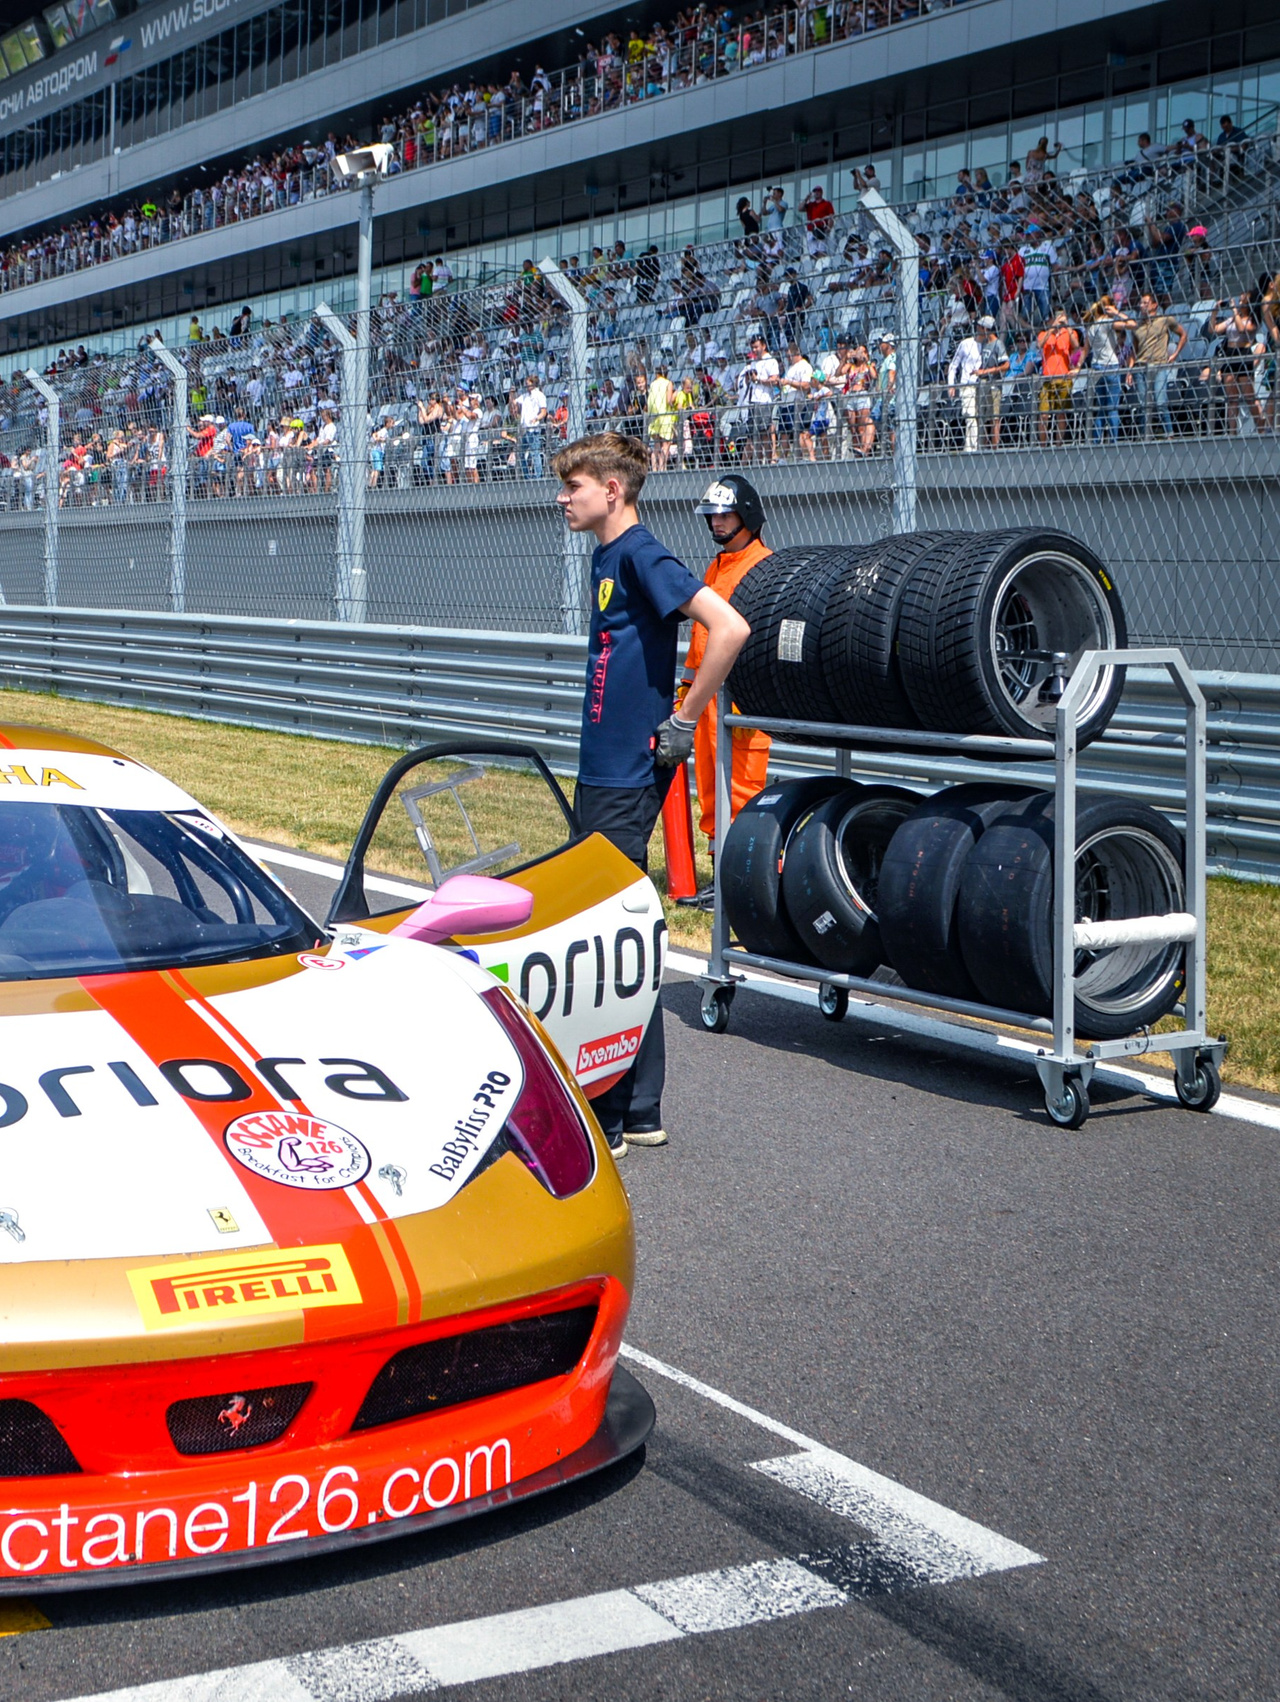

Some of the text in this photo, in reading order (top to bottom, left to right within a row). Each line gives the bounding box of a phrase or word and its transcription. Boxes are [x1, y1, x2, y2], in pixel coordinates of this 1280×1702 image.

[25, 52, 98, 106] АВТОДРОМ
[578, 1034, 638, 1071] brembo
[230, 1114, 327, 1148] OCTANE
[428, 1071, 511, 1181] BaByliss PRO
[238, 1147, 305, 1184] Breakfast
[314, 1174, 336, 1184] for
[306, 1141, 343, 1154] 126
[150, 1257, 338, 1315] PIRELLI
